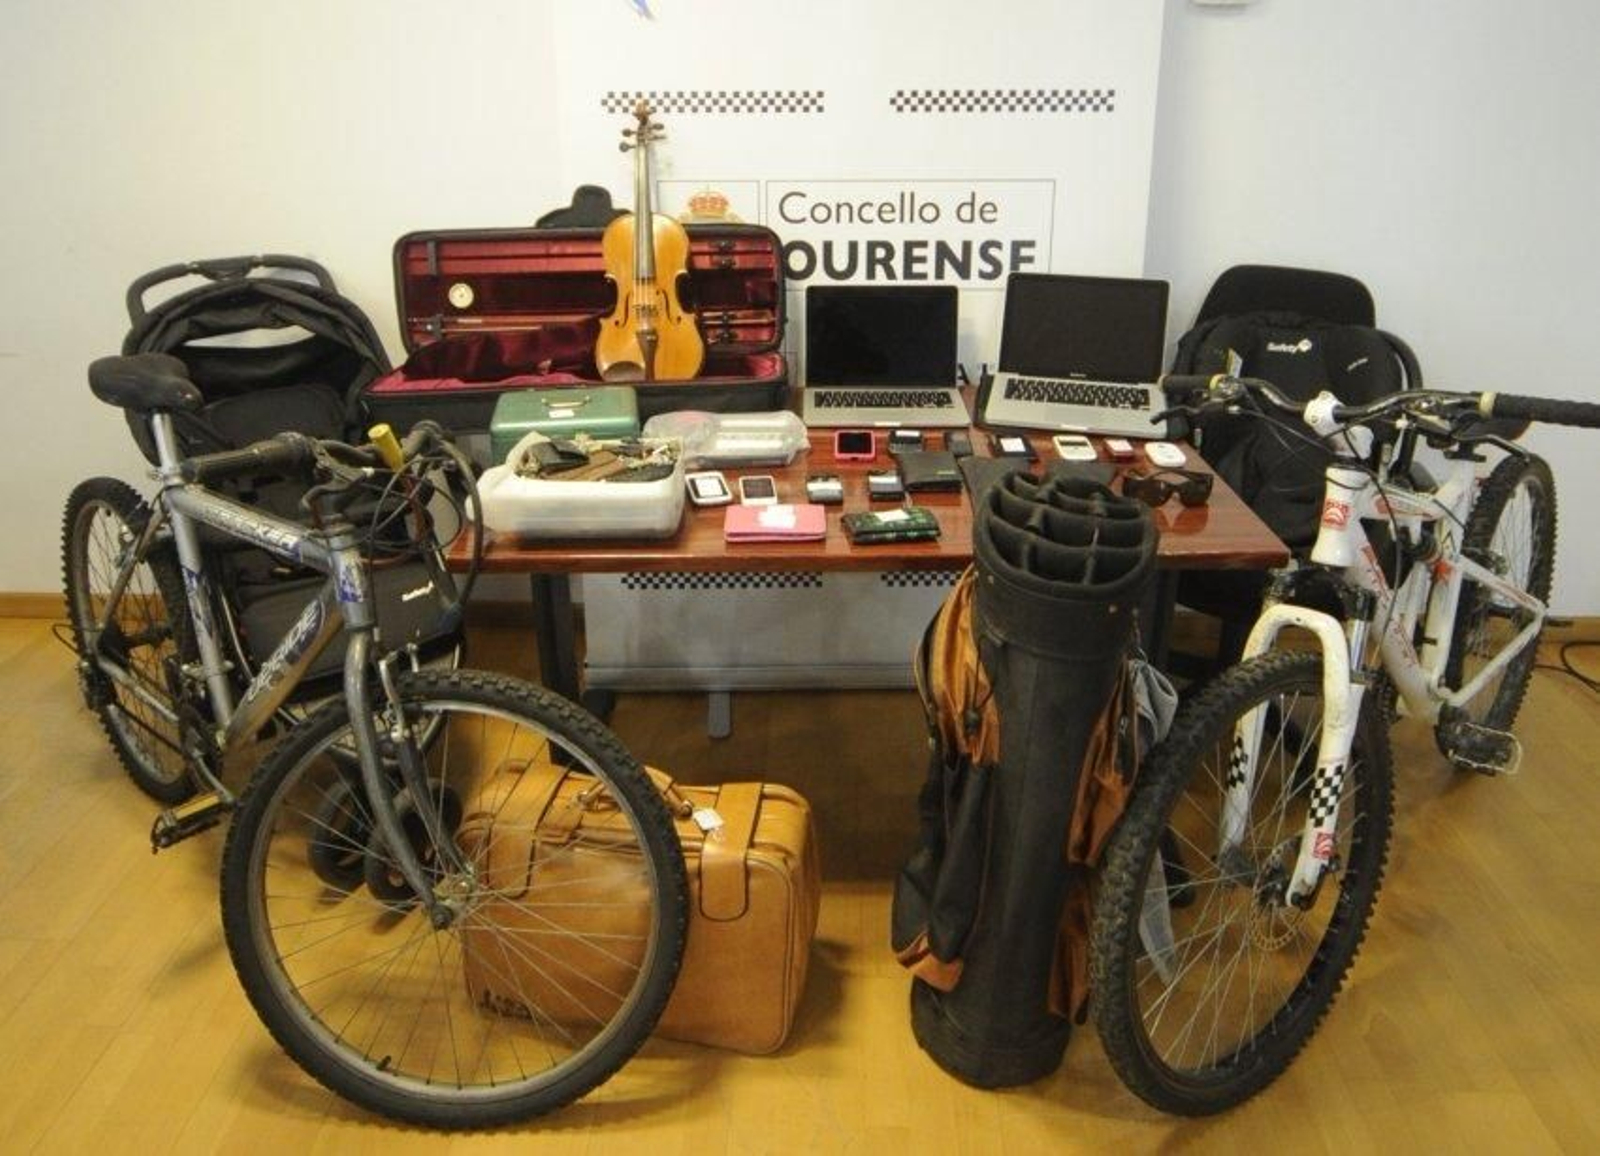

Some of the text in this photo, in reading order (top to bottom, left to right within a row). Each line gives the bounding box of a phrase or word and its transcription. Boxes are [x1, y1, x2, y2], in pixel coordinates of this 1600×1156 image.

[779, 191, 998, 224] Concello de
[783, 240, 1037, 281] OURENSE
